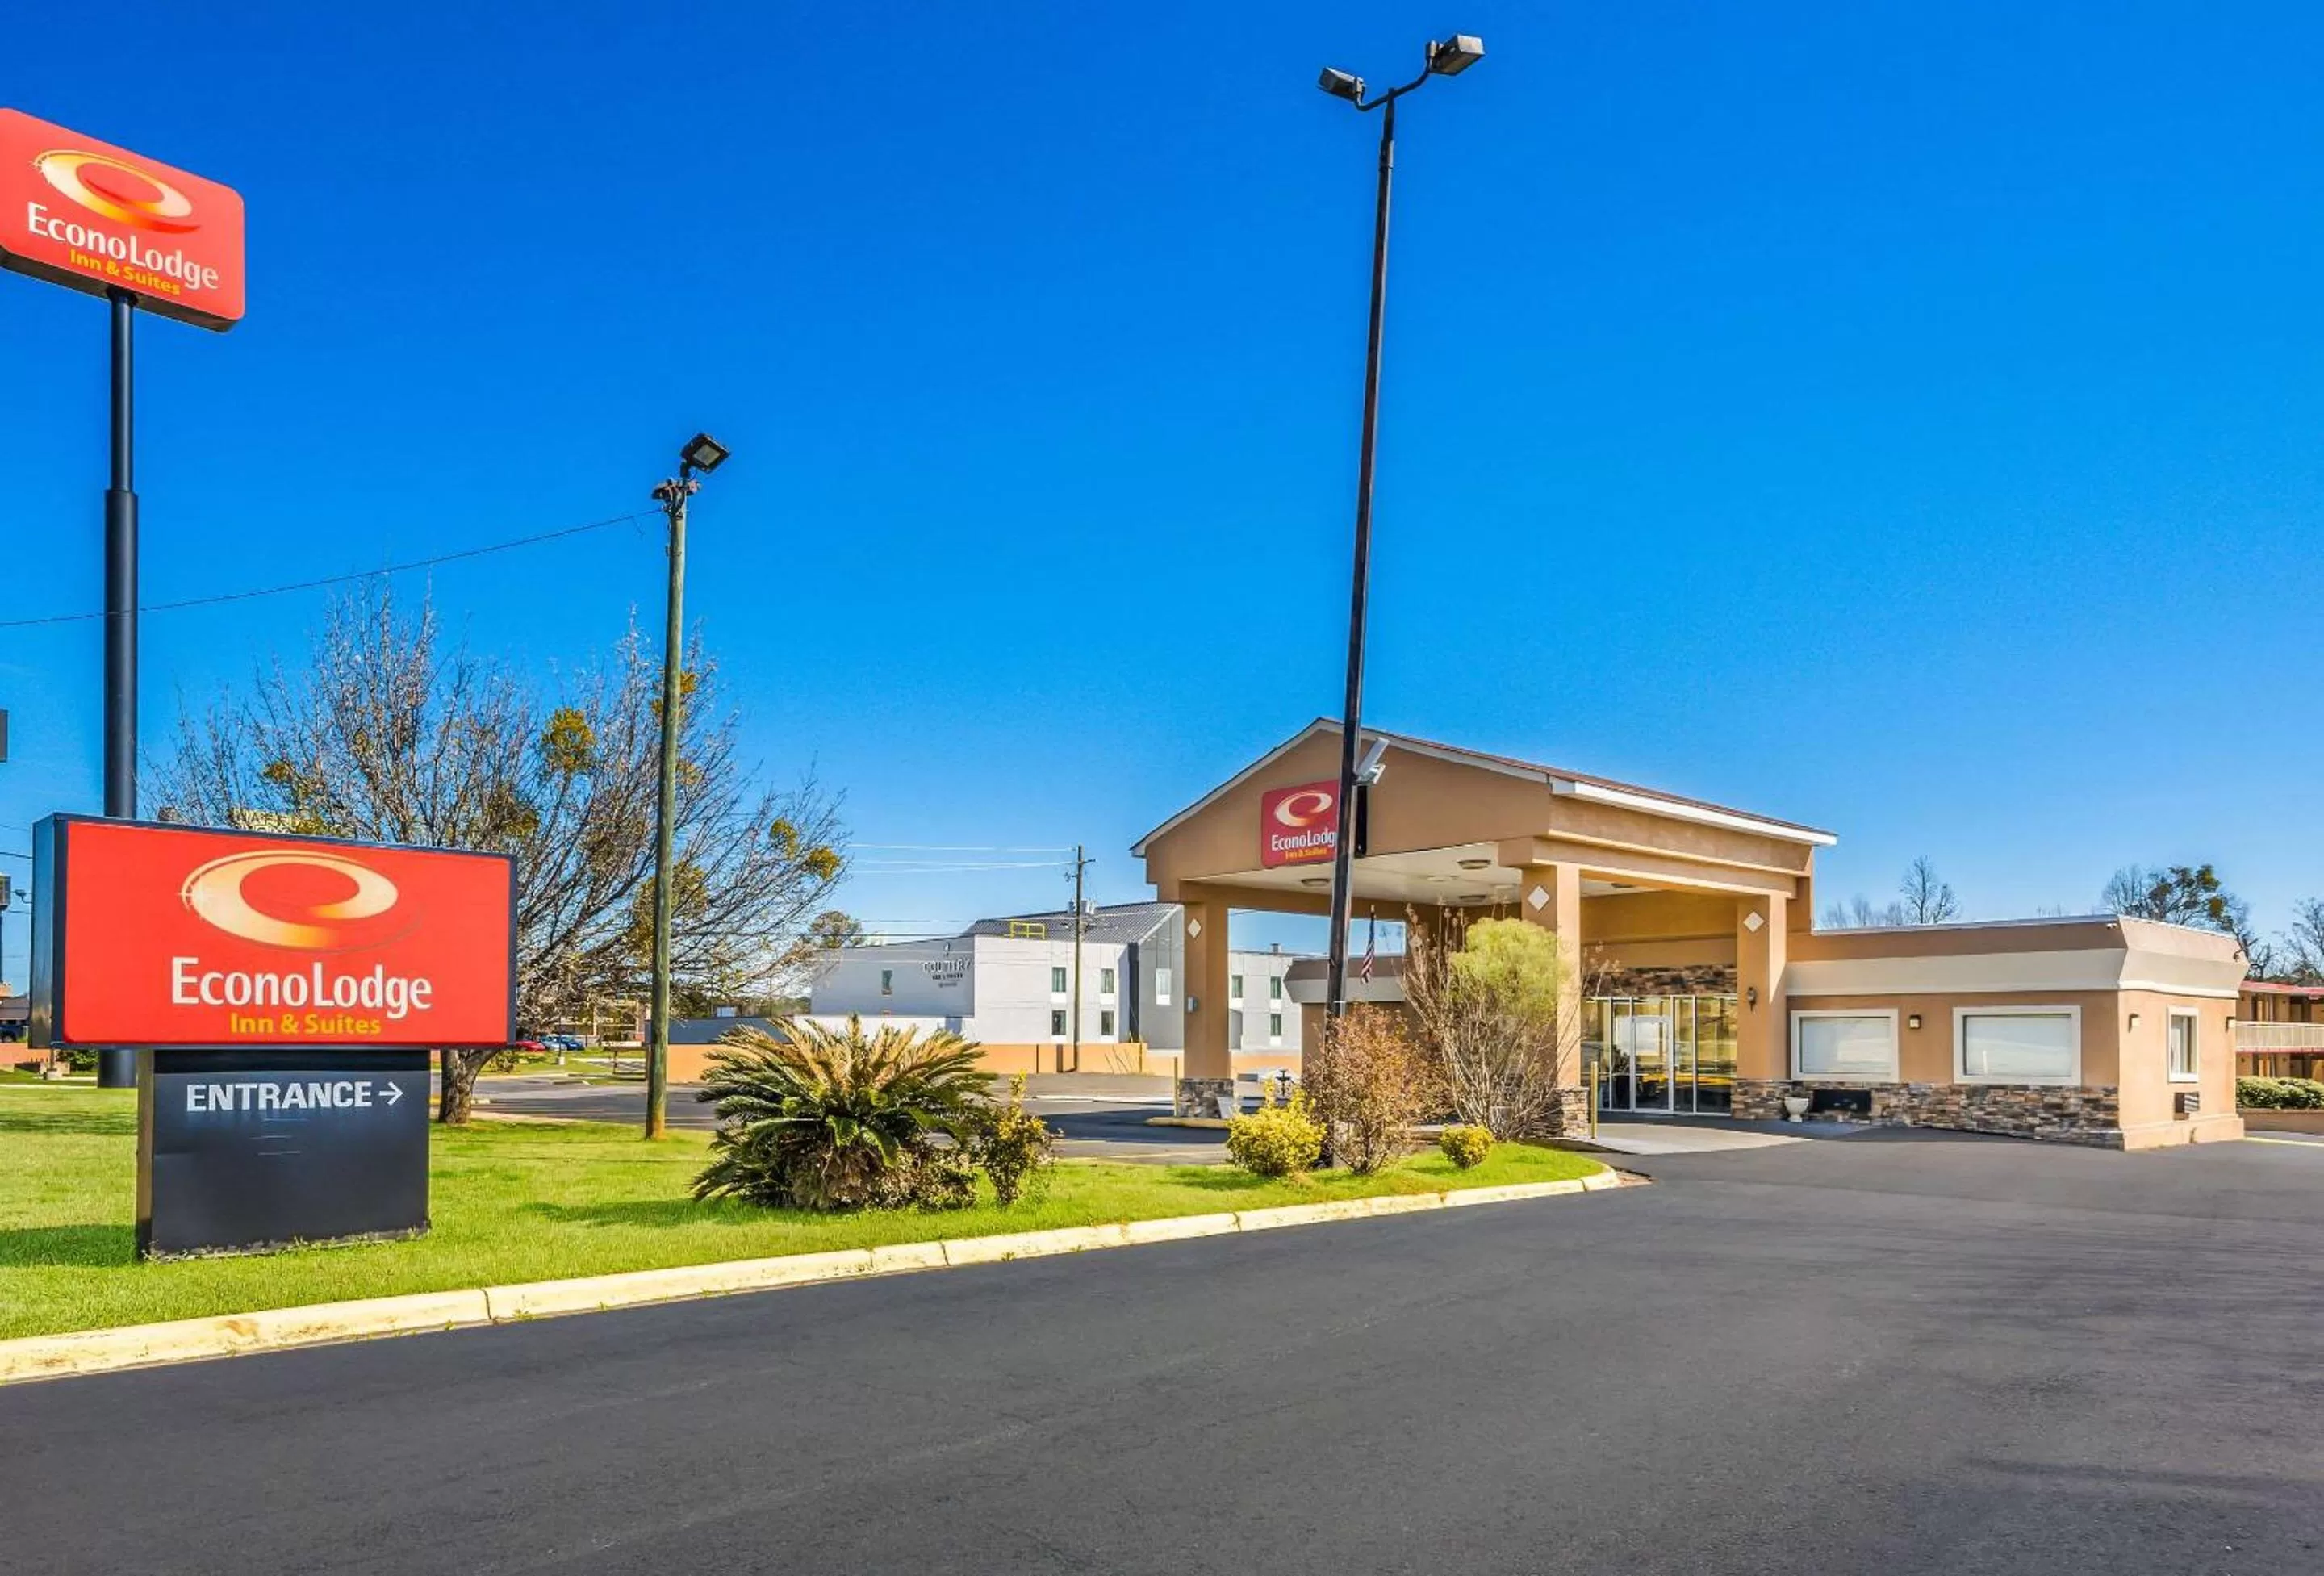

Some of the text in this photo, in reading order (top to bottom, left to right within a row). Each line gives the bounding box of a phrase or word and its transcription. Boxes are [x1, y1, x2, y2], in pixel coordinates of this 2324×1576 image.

[27, 201, 219, 291] EconoLodge
[69, 249, 181, 296] Inn & Suites
[1271, 827, 1338, 851] EconoLodg
[171, 956, 433, 1019] EconoLodge
[230, 1012, 382, 1035] Inn & Suites
[186, 1081, 373, 1113] ENTRANCE
